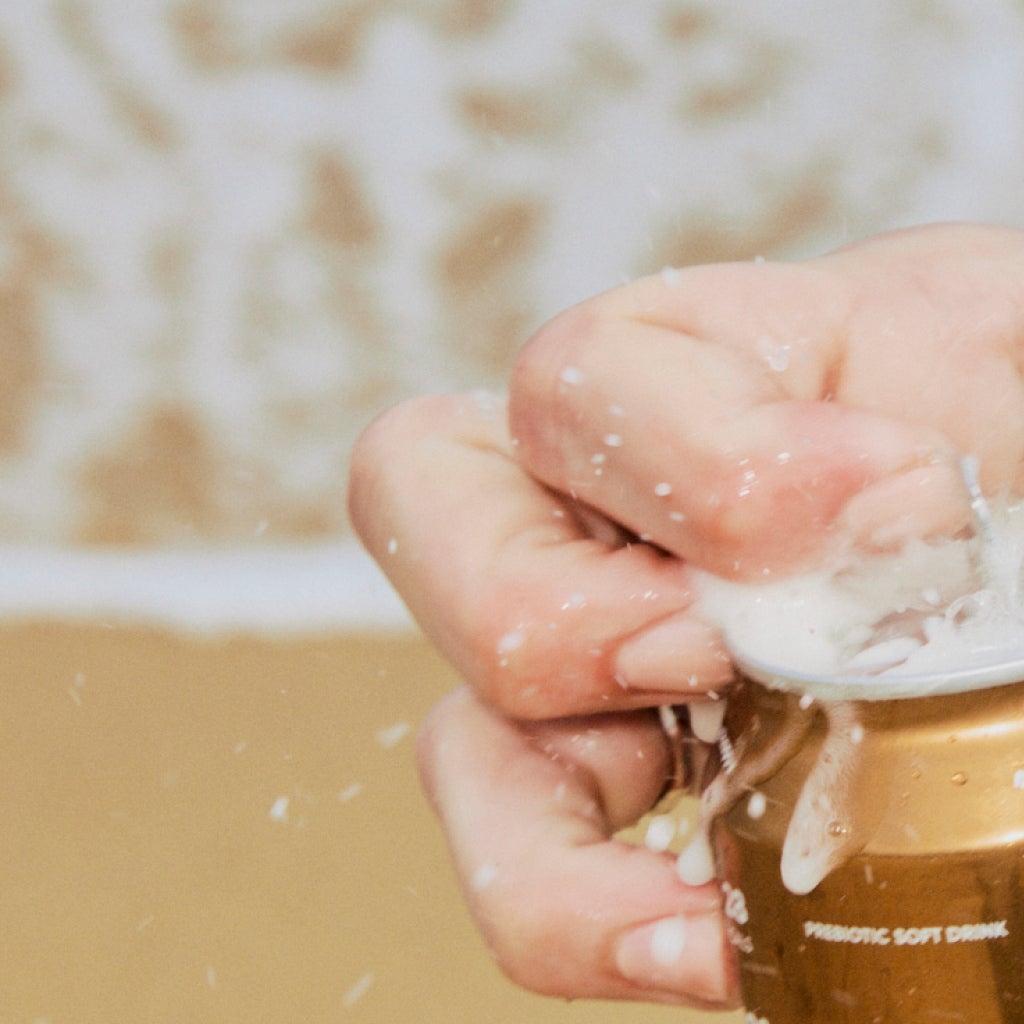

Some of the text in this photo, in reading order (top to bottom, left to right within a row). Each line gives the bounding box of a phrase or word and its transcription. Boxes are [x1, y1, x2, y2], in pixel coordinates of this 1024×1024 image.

[804, 919, 1010, 946] PREBIOTIC SOFT DRINK
